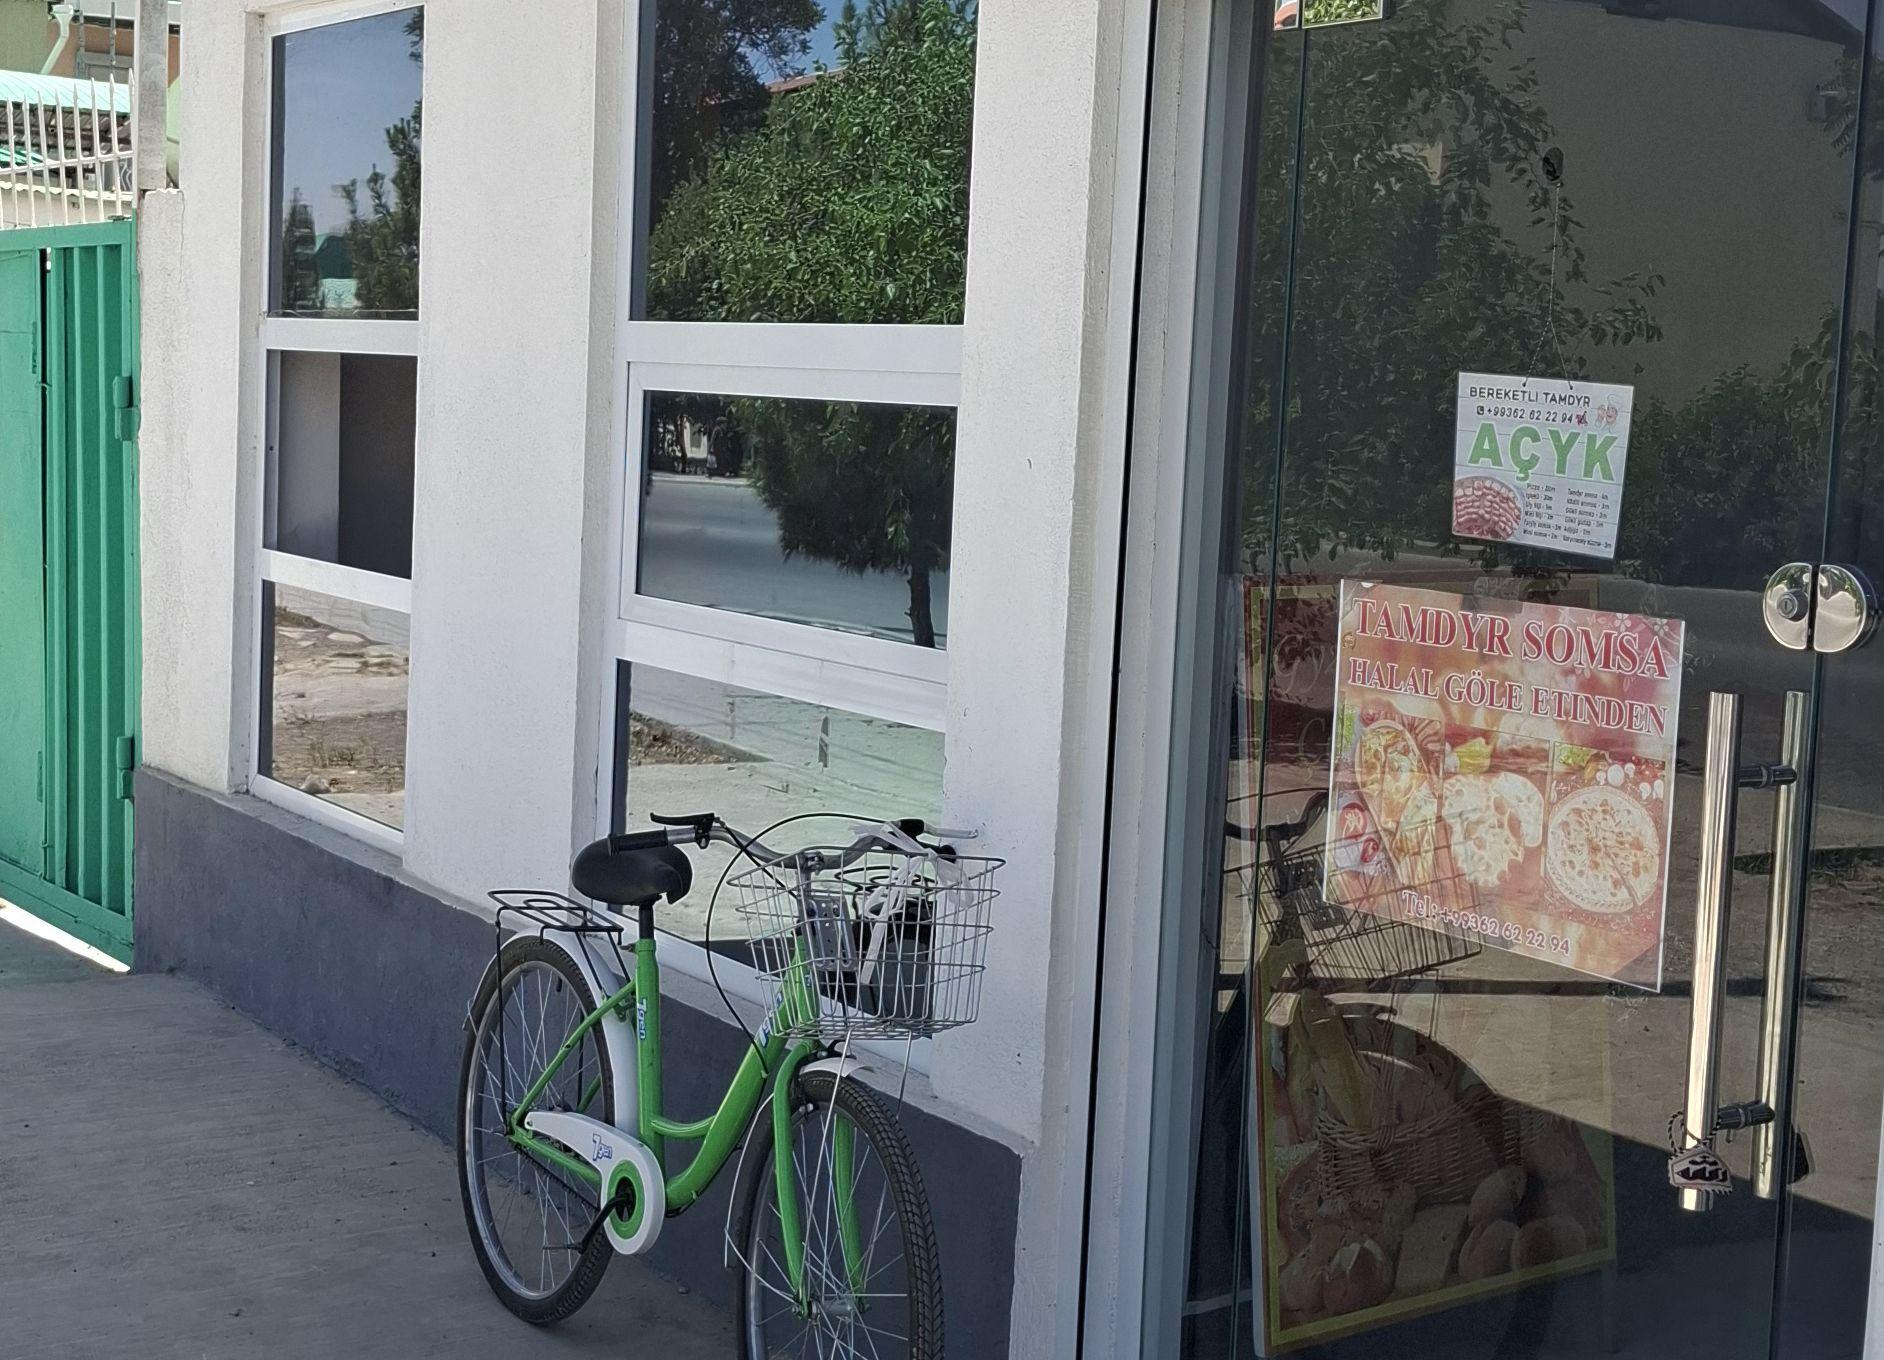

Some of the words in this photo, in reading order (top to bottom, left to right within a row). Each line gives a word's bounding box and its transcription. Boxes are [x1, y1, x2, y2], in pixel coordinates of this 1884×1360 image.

[1469, 386, 1539, 403] BEREKETLI
[1542, 391, 1591, 408] TAMDYR
[1486, 406, 1526, 420] +99362
[1529, 409, 1542, 421] 62
[1545, 410, 1558, 423] 22
[1561, 412, 1574, 424] 94
[1467, 421, 1619, 482] AÇYK
[1352, 597, 1514, 658] TAMDYR
[1522, 619, 1671, 680] SOMSA
[1348, 656, 1439, 700] HALAL
[1443, 670, 1524, 713] GÖLE
[1530, 685, 1669, 738] ETINDEN
[1402, 890, 1438, 922] Tel:
[1439, 907, 1500, 938] +99362
[1502, 922, 1523, 943] 62
[1526, 928, 1547, 951] 22
[1550, 935, 1571, 956] 94
